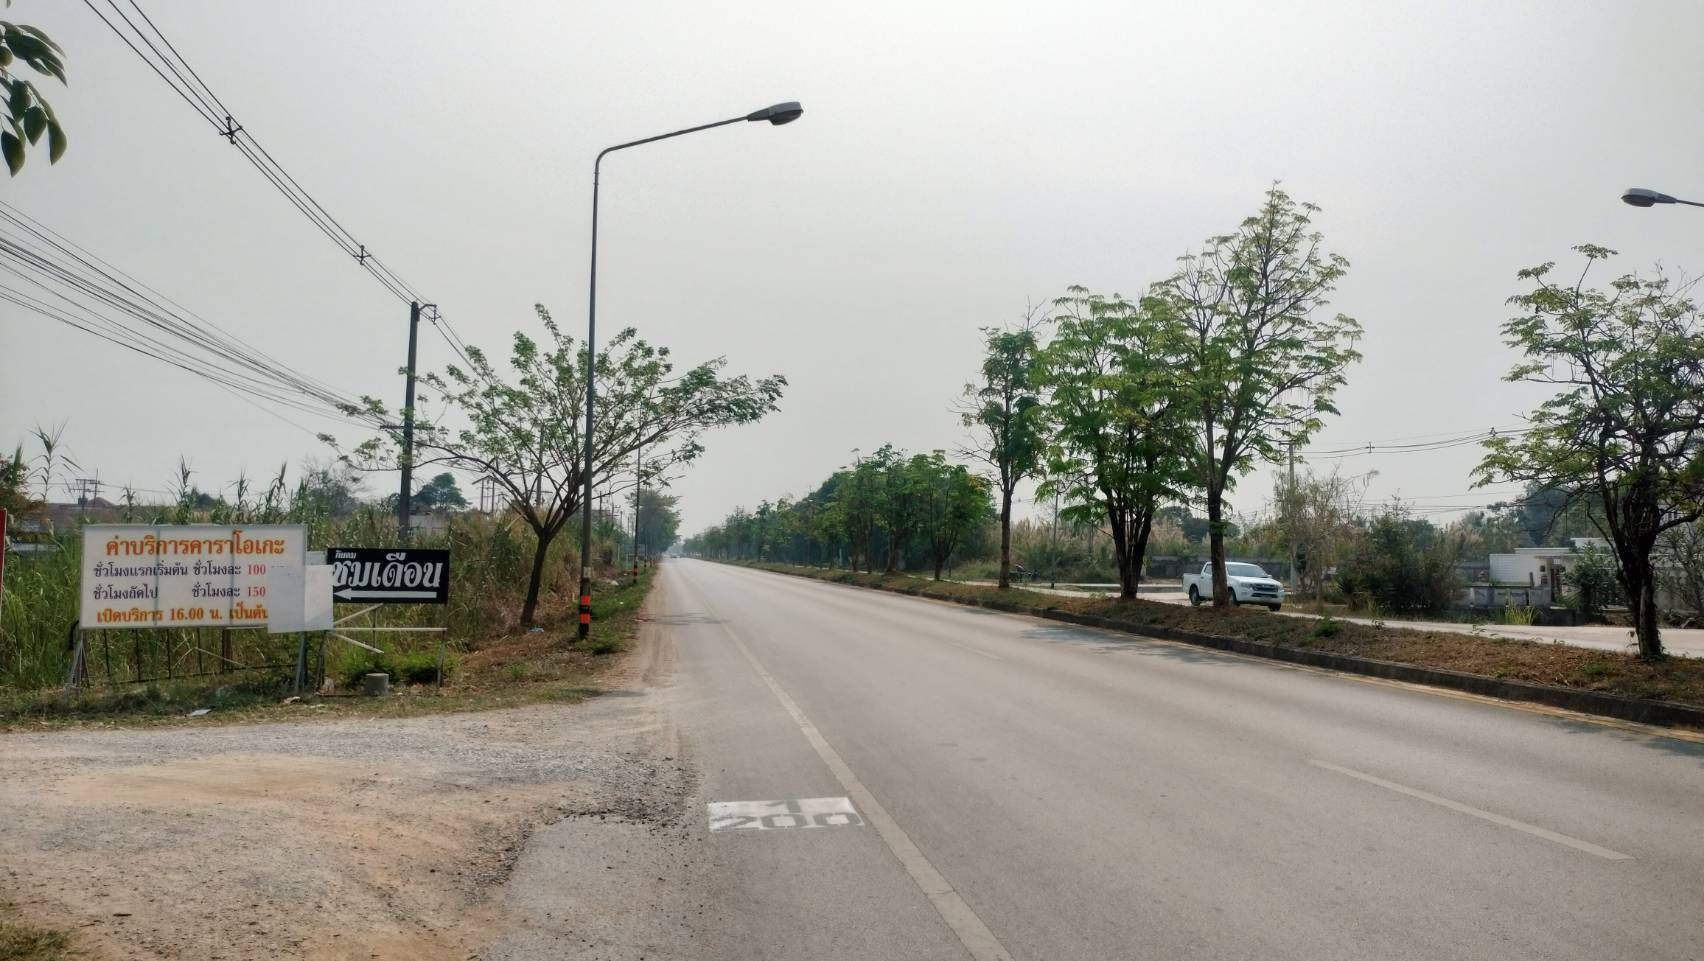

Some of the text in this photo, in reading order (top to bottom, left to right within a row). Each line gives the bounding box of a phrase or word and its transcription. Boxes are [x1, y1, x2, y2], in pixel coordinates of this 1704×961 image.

[106, 529, 285, 556] ค่าบริการคาราโอเกะ
[93, 560, 266, 577] ชั่วโมงแรกเริ่มต้น ชั่วโมงละ 100
[332, 552, 443, 588] ชมเดือน
[93, 582, 266, 600] ชั่วโมงถัดไป ชั่วโมงละ 150
[96, 607, 163, 623] เปิดบริการ
[170, 607, 204, 621] 16.00
